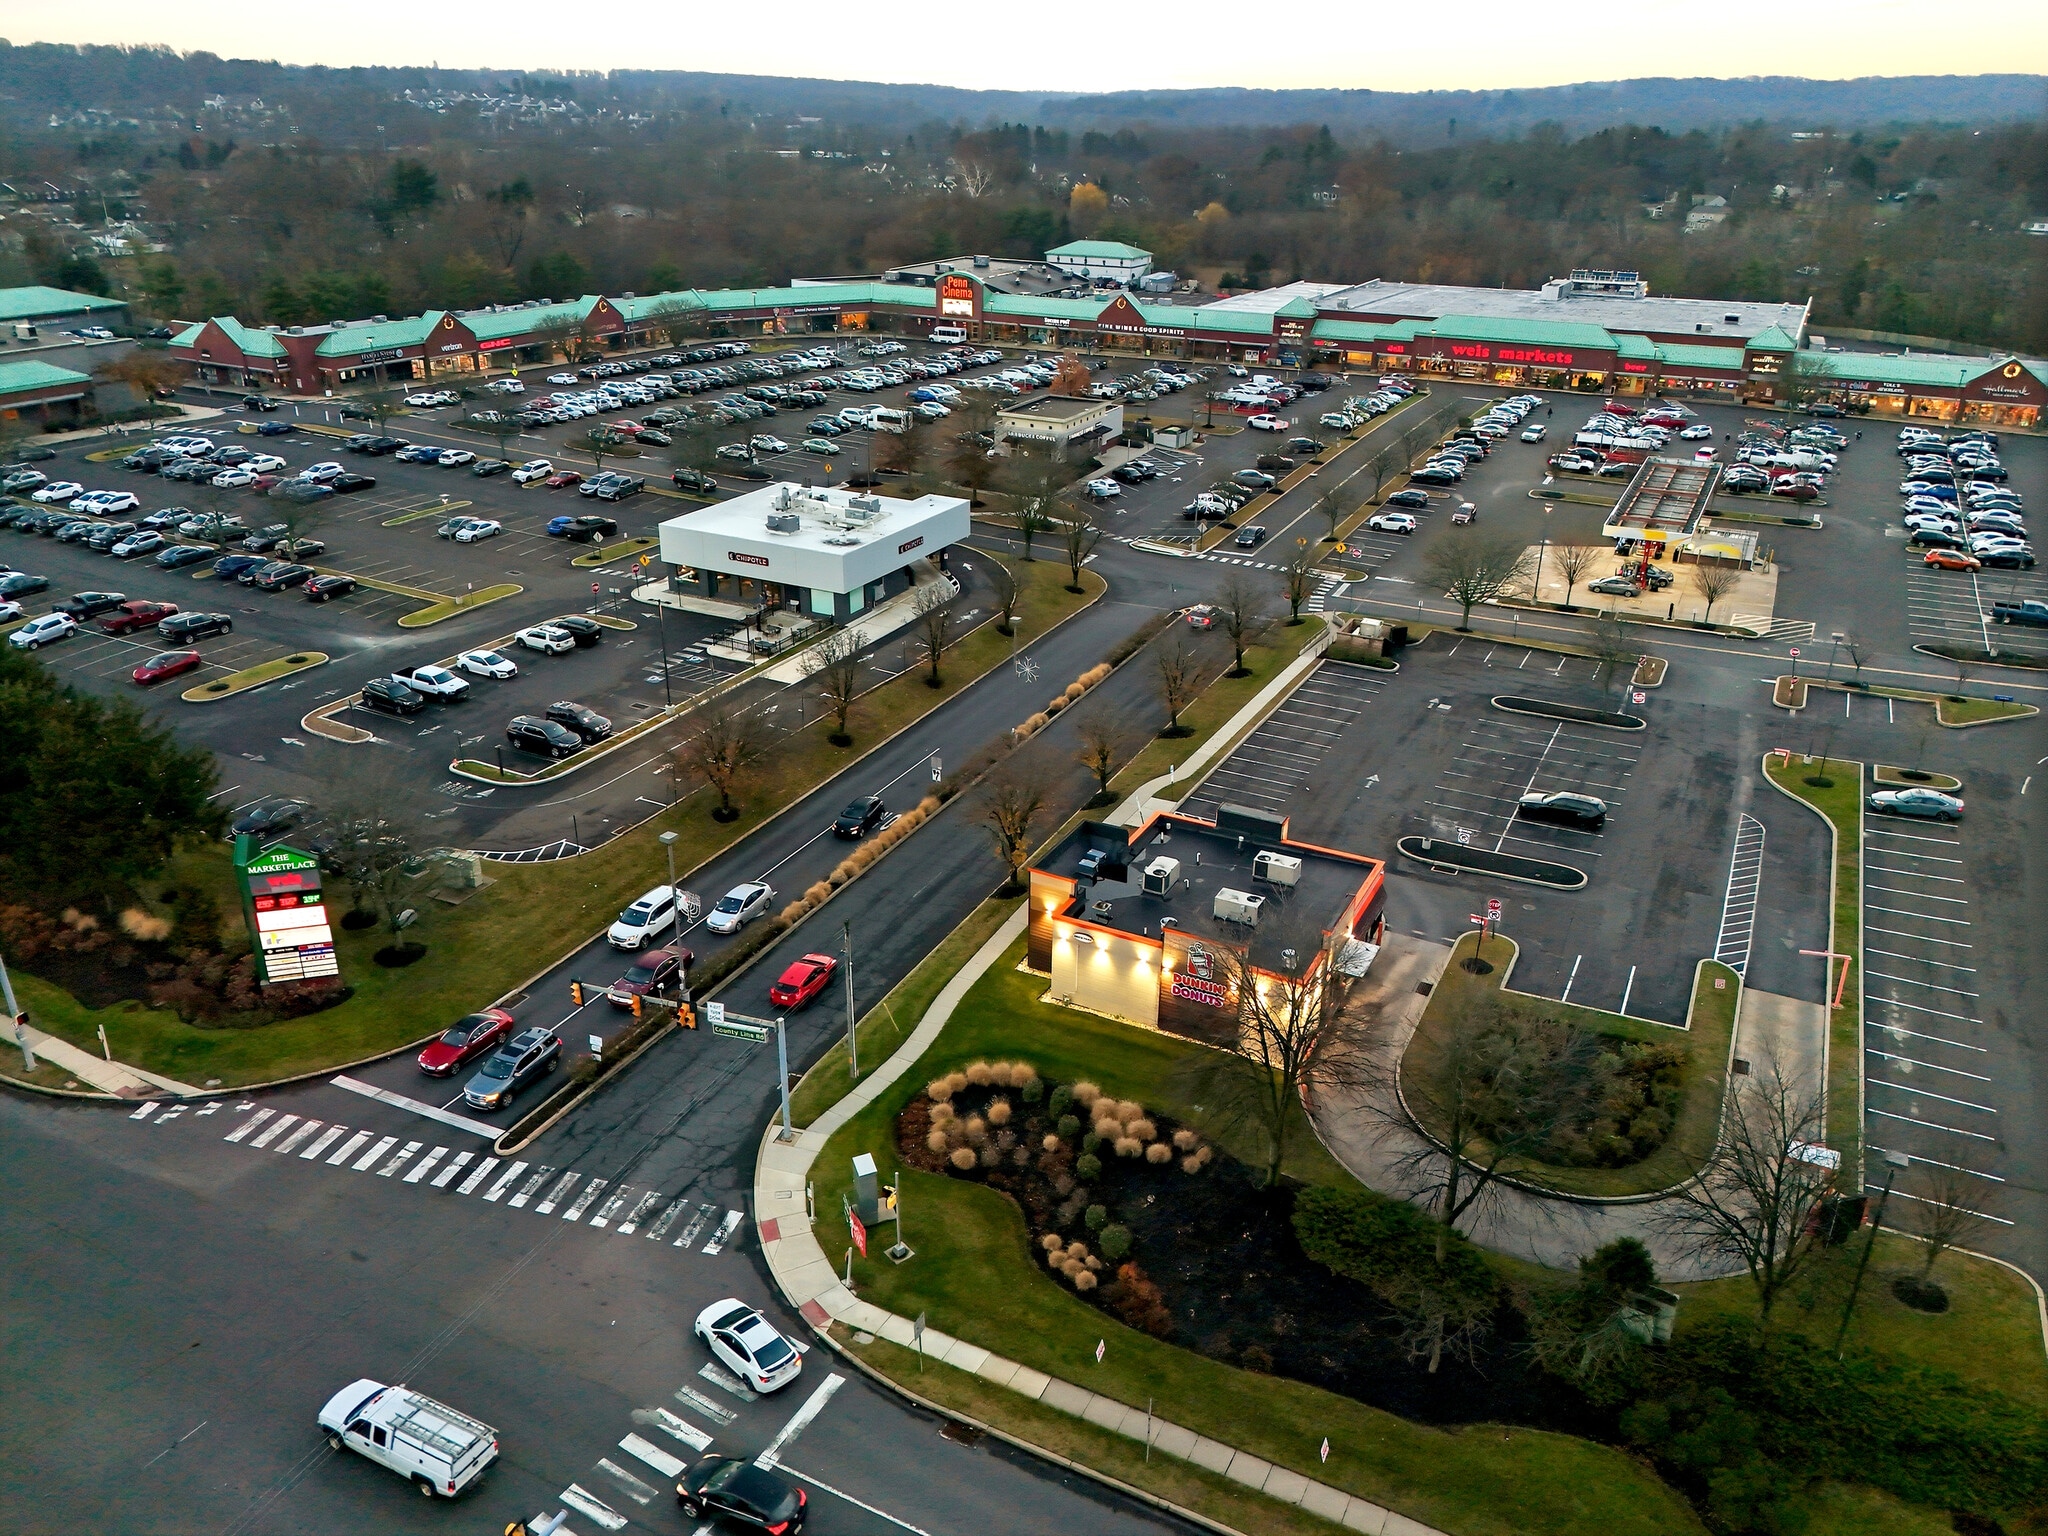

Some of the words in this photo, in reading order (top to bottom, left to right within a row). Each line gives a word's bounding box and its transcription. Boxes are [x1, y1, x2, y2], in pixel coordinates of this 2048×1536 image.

[947, 275, 968, 288] Penn
[942, 285, 973, 298] Cinema
[1159, 327, 1184, 335] SPIRITS
[441, 343, 463, 352] verizon
[480, 339, 511, 348] GNC
[1387, 344, 1405, 353] deli
[1452, 344, 1490, 358] weis
[1498, 349, 1573, 364] markets
[1849, 381, 1870, 390] child
[1981, 385, 2031, 396] Hallmark
[1036, 434, 1056, 442] COFFEE
[735, 554, 768, 565] CHIPOTLE
[270, 853, 290, 862] THE
[247, 860, 316, 874] MARKETPLACE
[1173, 972, 1227, 995] DUNKIN'
[1171, 983, 1225, 1008] DONUTS
[715, 1027, 738, 1036] County
